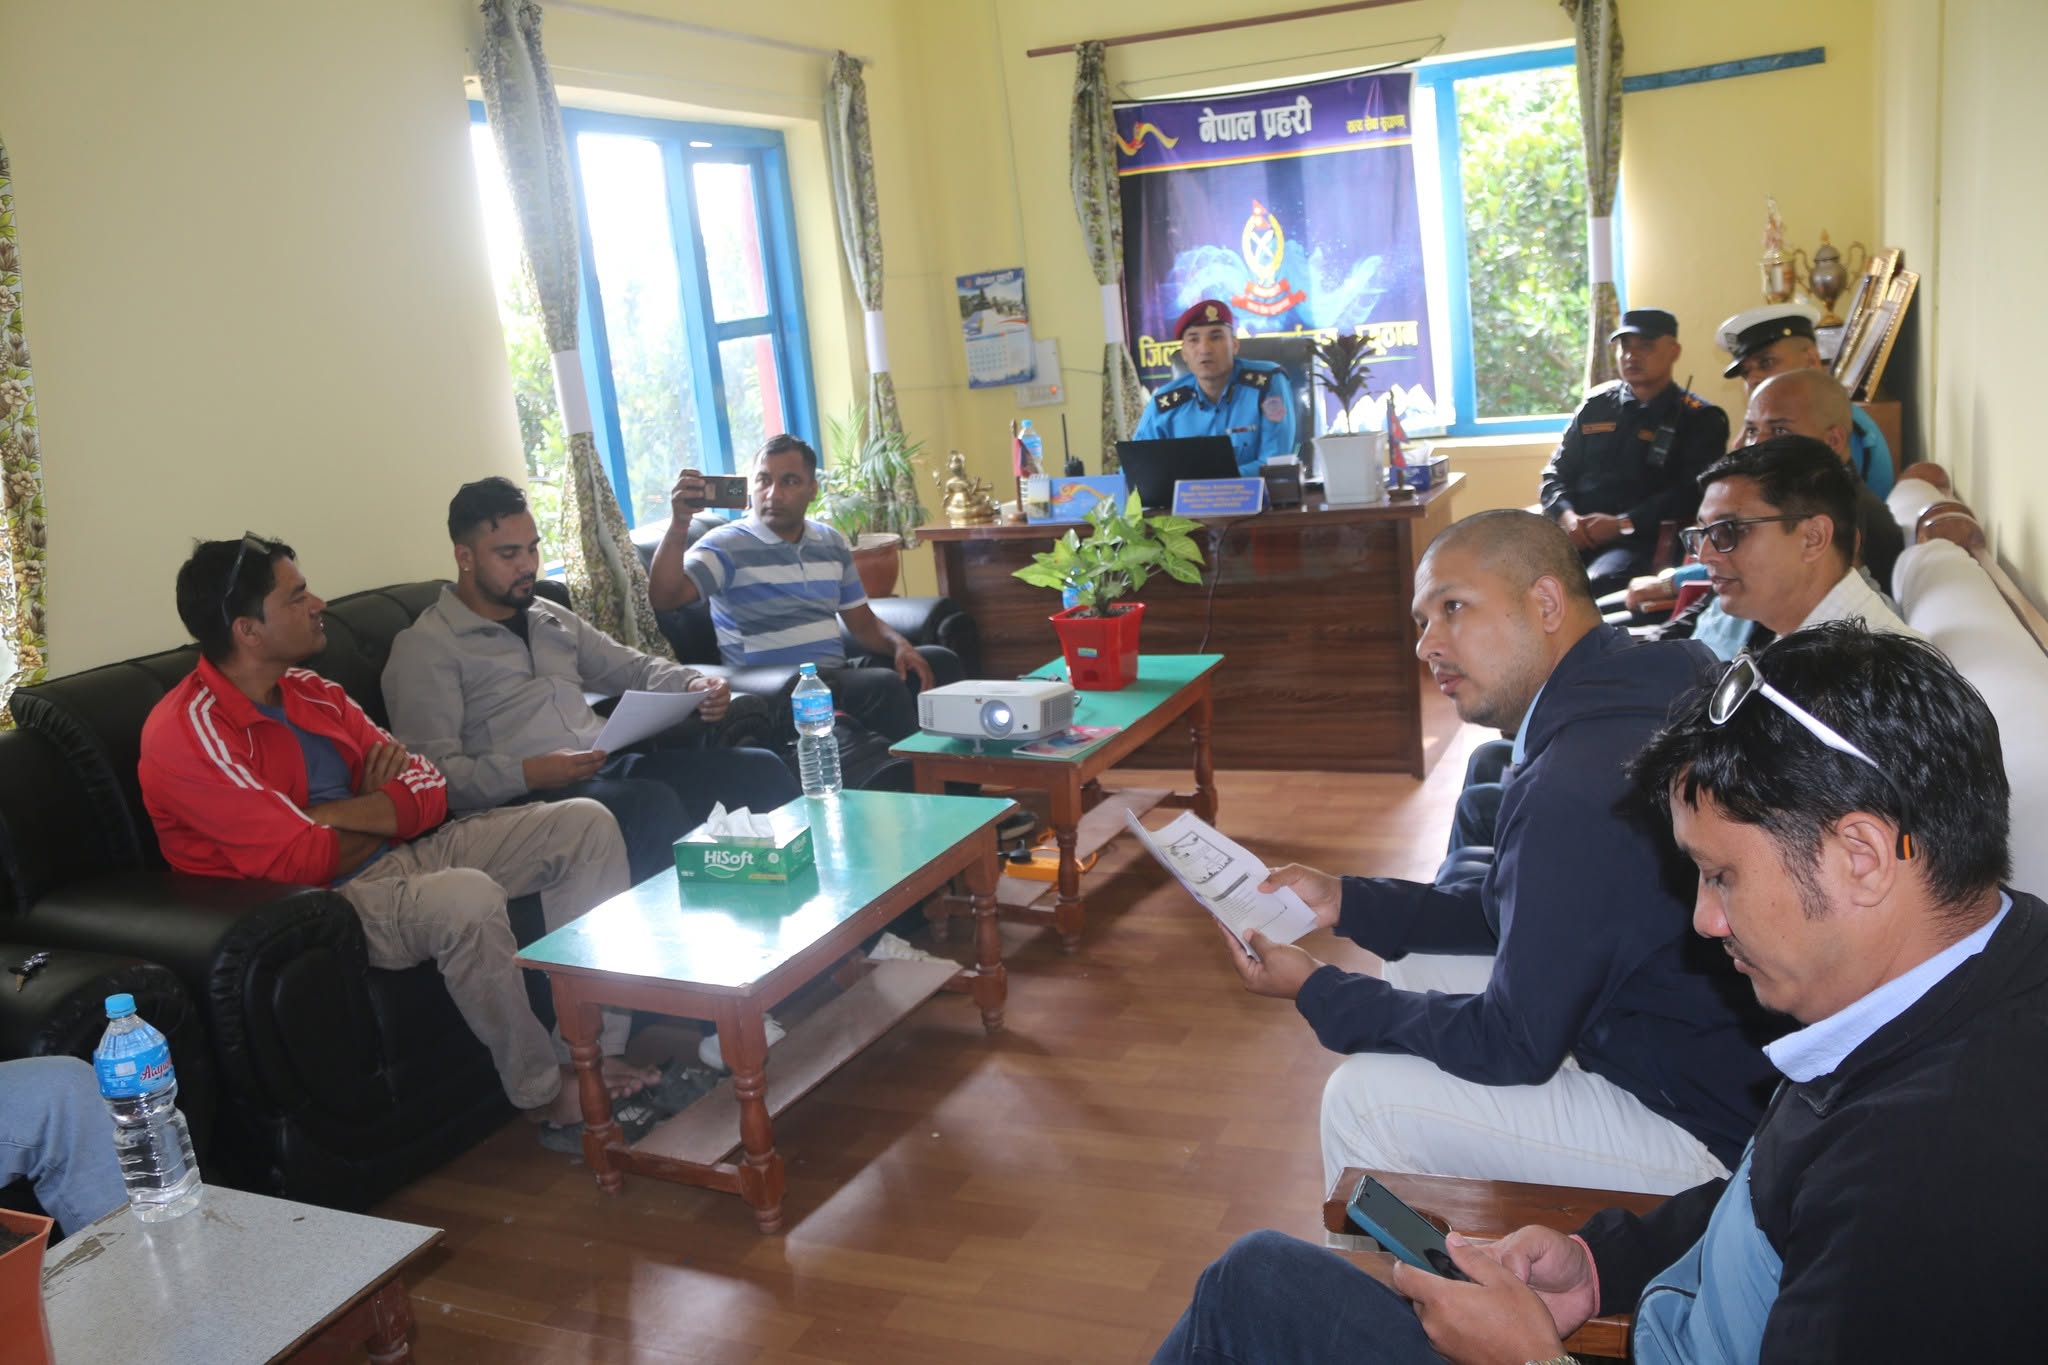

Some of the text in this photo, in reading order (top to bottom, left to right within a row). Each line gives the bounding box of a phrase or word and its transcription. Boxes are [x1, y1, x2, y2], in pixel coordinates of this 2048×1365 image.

[1198, 95, 1313, 144] नेपाल प्रहरी
[704, 851, 754, 868] HiSoft
